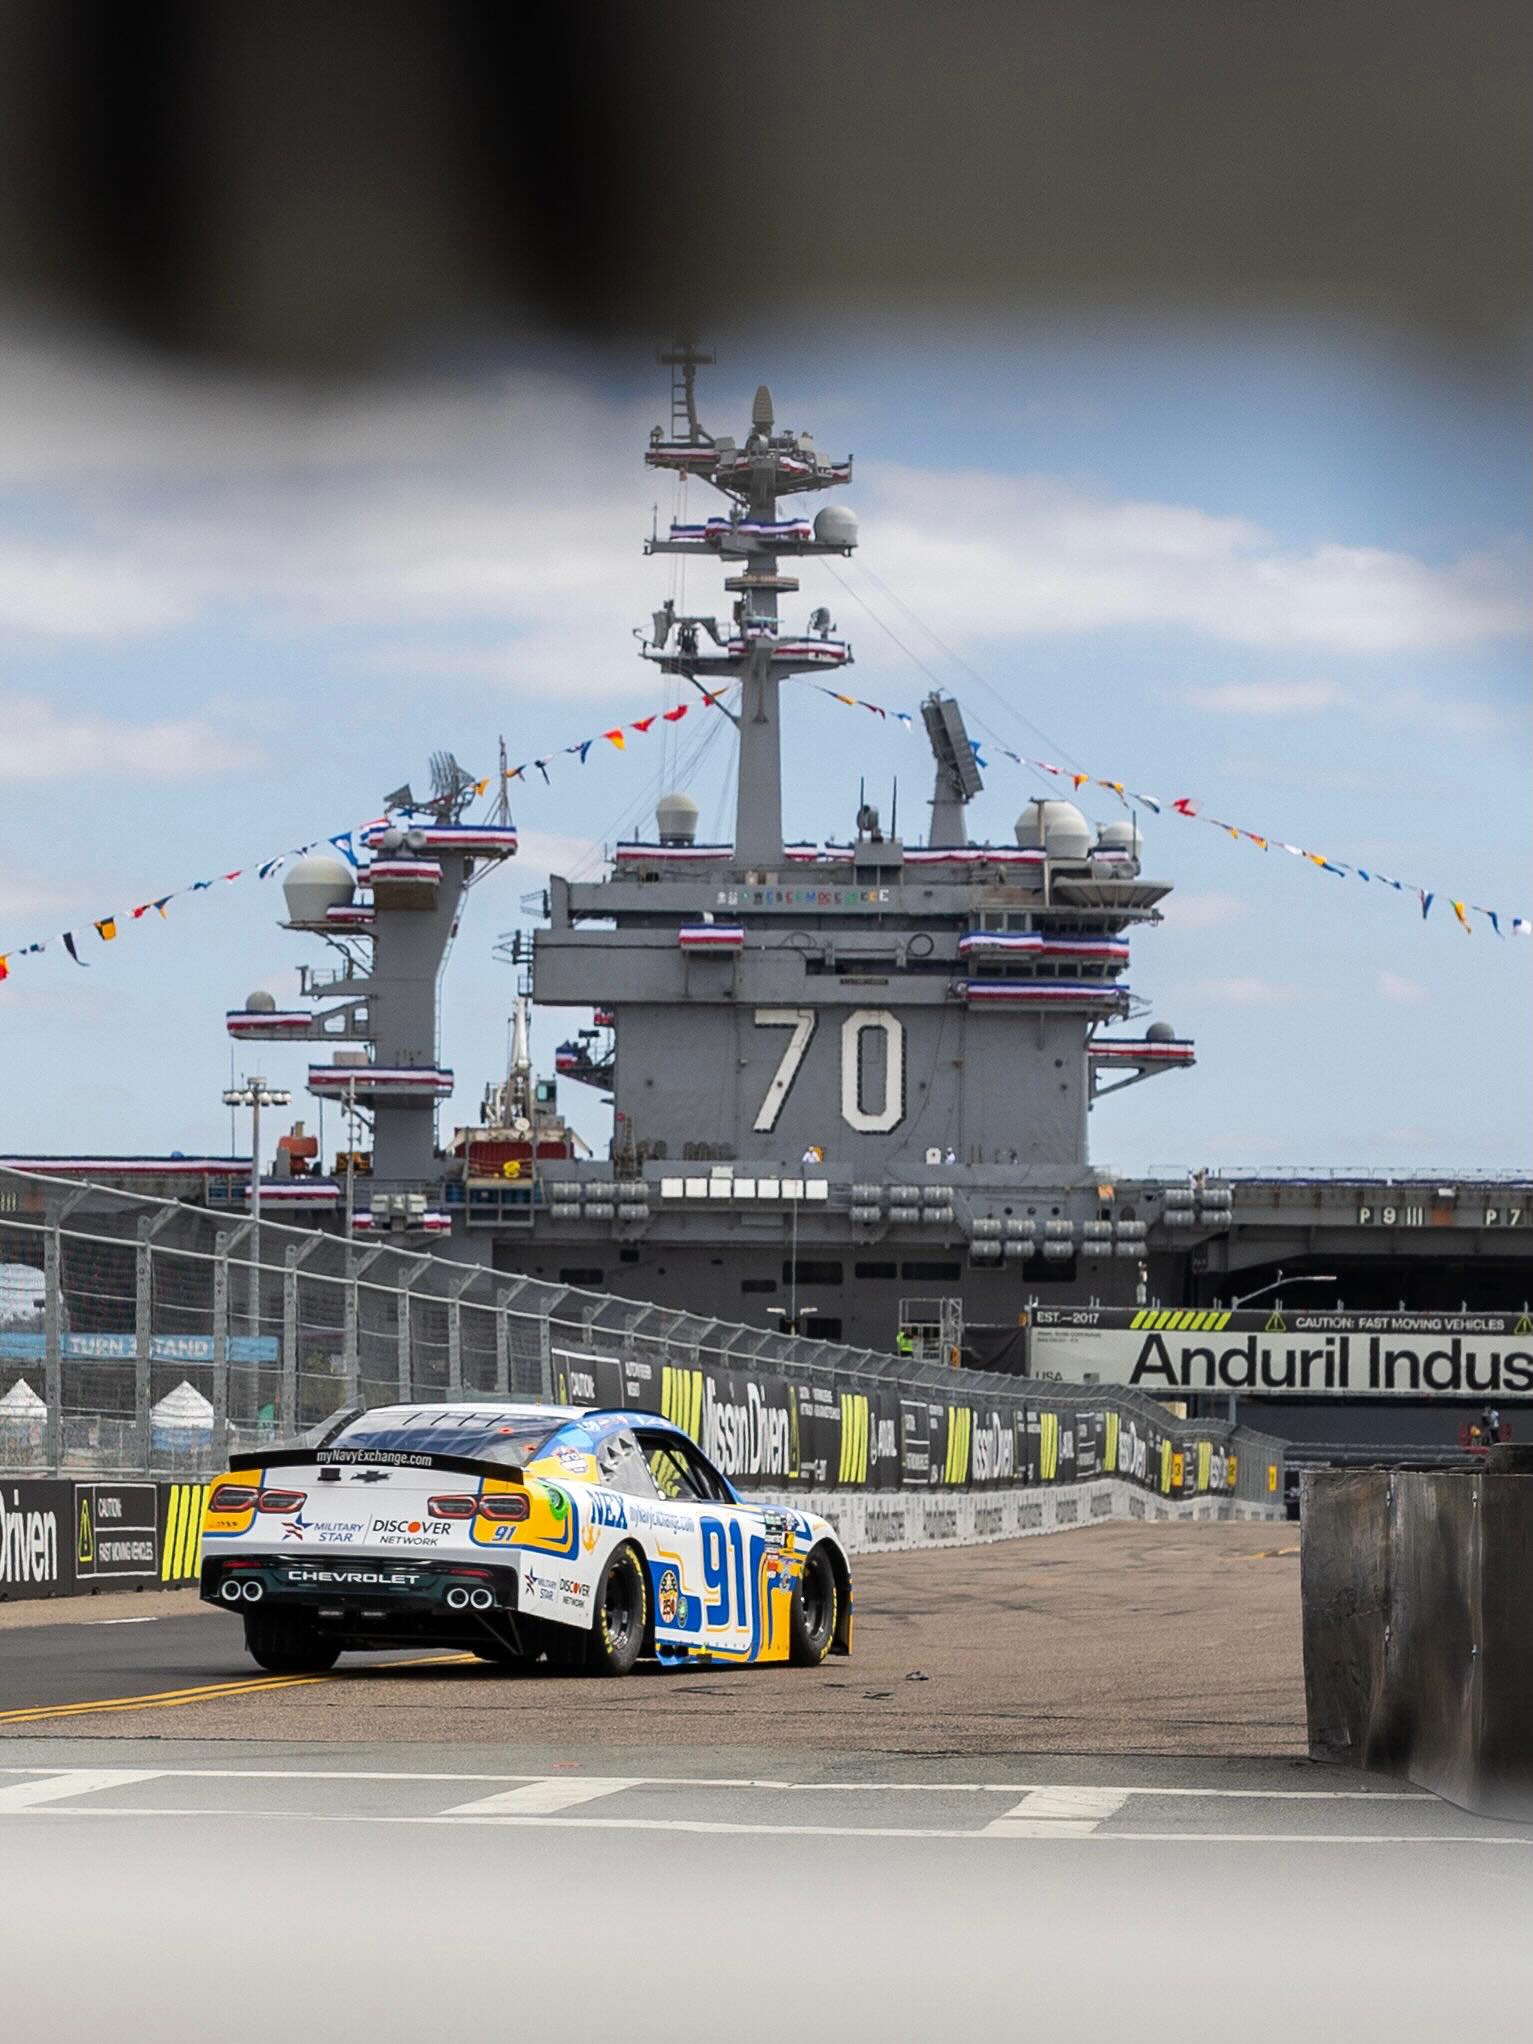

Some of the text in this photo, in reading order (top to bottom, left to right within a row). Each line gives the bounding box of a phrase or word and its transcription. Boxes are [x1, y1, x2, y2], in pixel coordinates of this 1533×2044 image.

[753, 1009, 906, 1136] 70
[1359, 1207, 1371, 1225] P
[1485, 1209, 1521, 1226] P 7
[1296, 1317, 1505, 1331] CAUTION: FAST MOVING VEHICLES
[69, 1338, 123, 1354] TURN
[1129, 1333, 1533, 1391] Anduril Indus
[1035, 1371, 1064, 1383] USA
[316, 1449, 433, 1467] myNavyExchange.com
[585, 1488, 629, 1530] NEX
[314, 1522, 365, 1532] MILITARY
[372, 1520, 452, 1535] DISCOVER
[492, 1525, 517, 1542] 91
[318, 1532, 353, 1543] STAR
[379, 1535, 438, 1546] NETWORK
[288, 1571, 420, 1584] CHEVROLET
[700, 1515, 748, 1628] 91
[559, 1578, 591, 1598] DISCOVER
